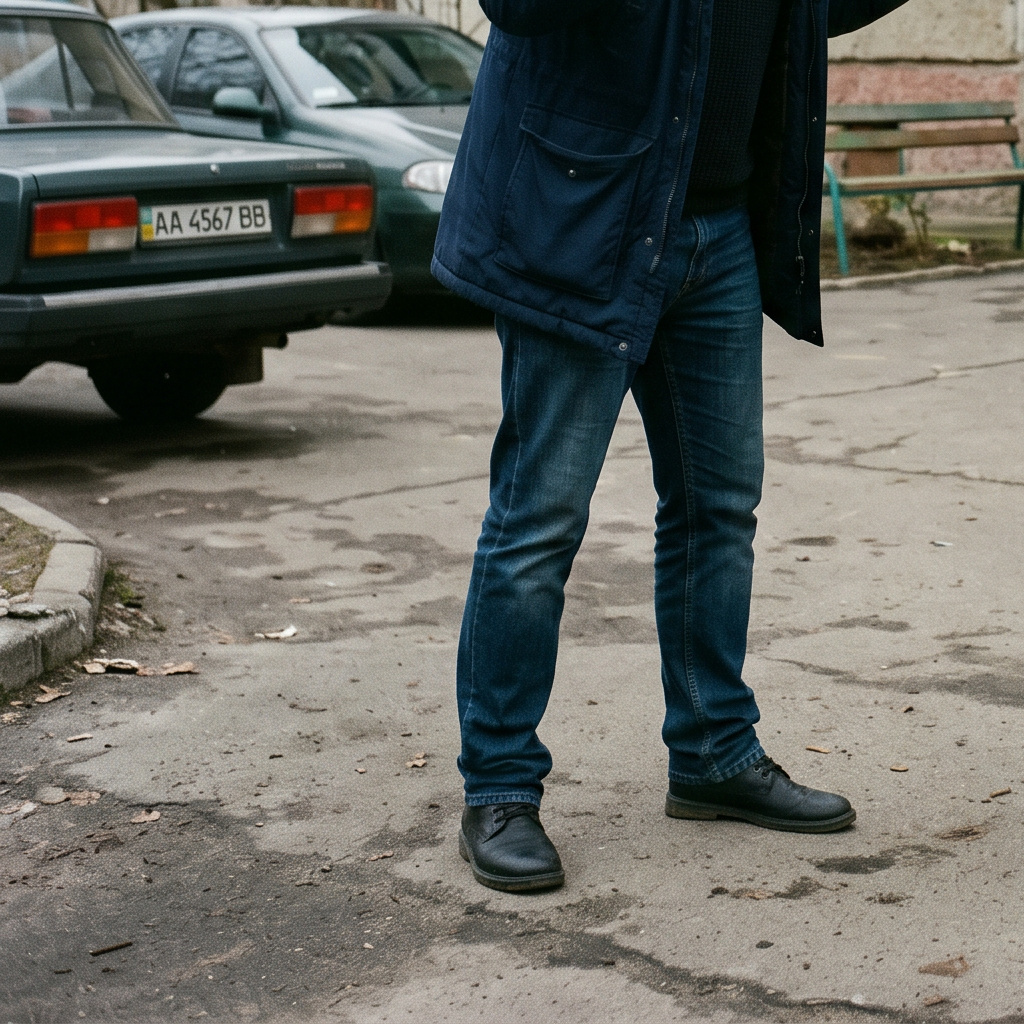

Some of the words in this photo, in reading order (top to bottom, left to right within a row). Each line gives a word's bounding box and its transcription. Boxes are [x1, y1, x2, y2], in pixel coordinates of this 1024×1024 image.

[156, 210, 183, 235] AA
[189, 206, 233, 232] 4567
[239, 204, 267, 229] BB
